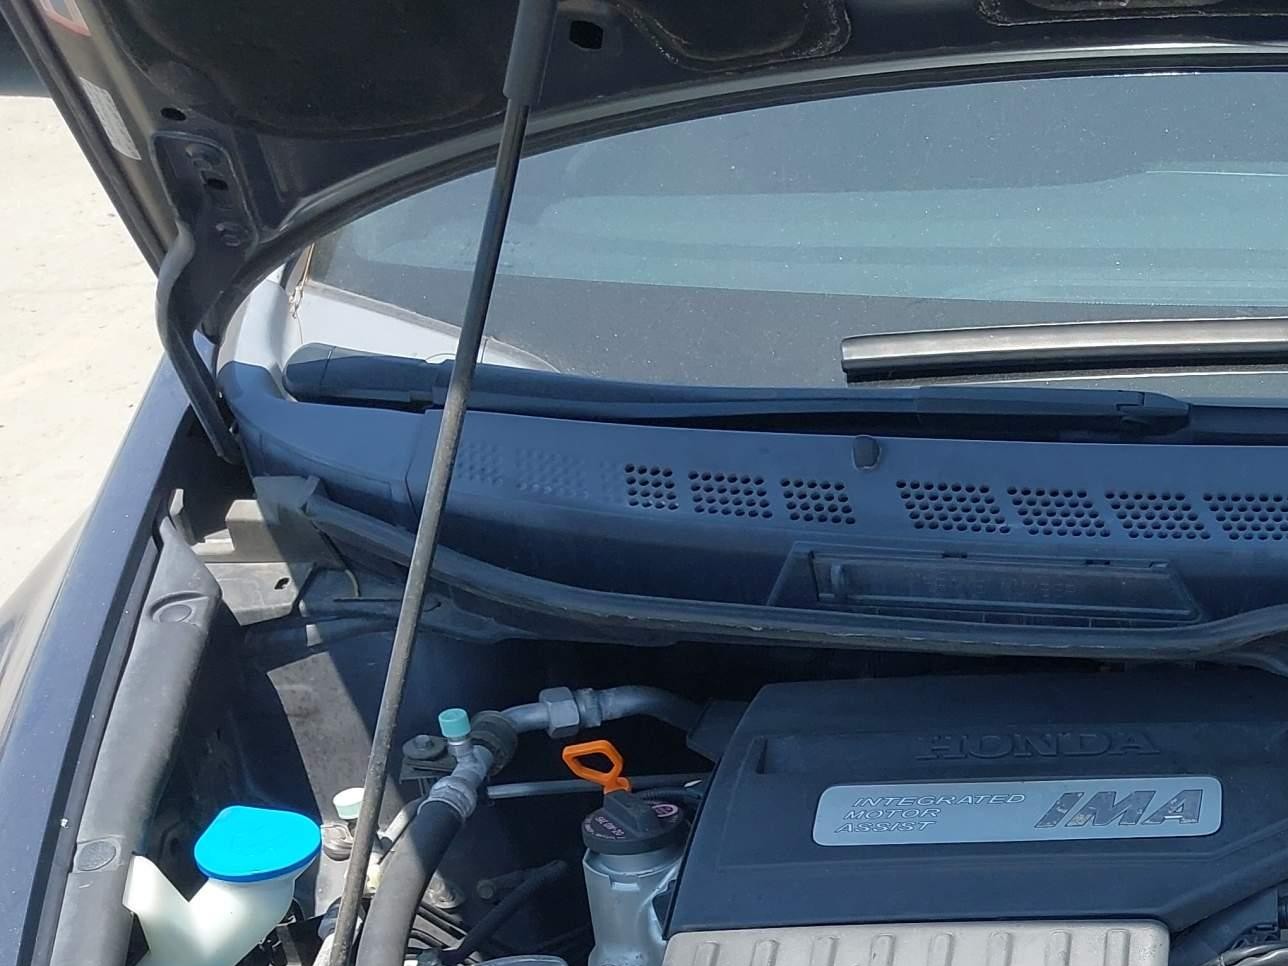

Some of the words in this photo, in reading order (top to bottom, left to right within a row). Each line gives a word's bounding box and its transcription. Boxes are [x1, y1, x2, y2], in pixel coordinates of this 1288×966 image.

[915, 731, 1161, 761] HONDA
[851, 793, 1026, 808] INTEGRATED
[843, 807, 942, 821] MOTOR
[1033, 788, 1205, 829] IMA
[833, 820, 937, 834] ASSIST
